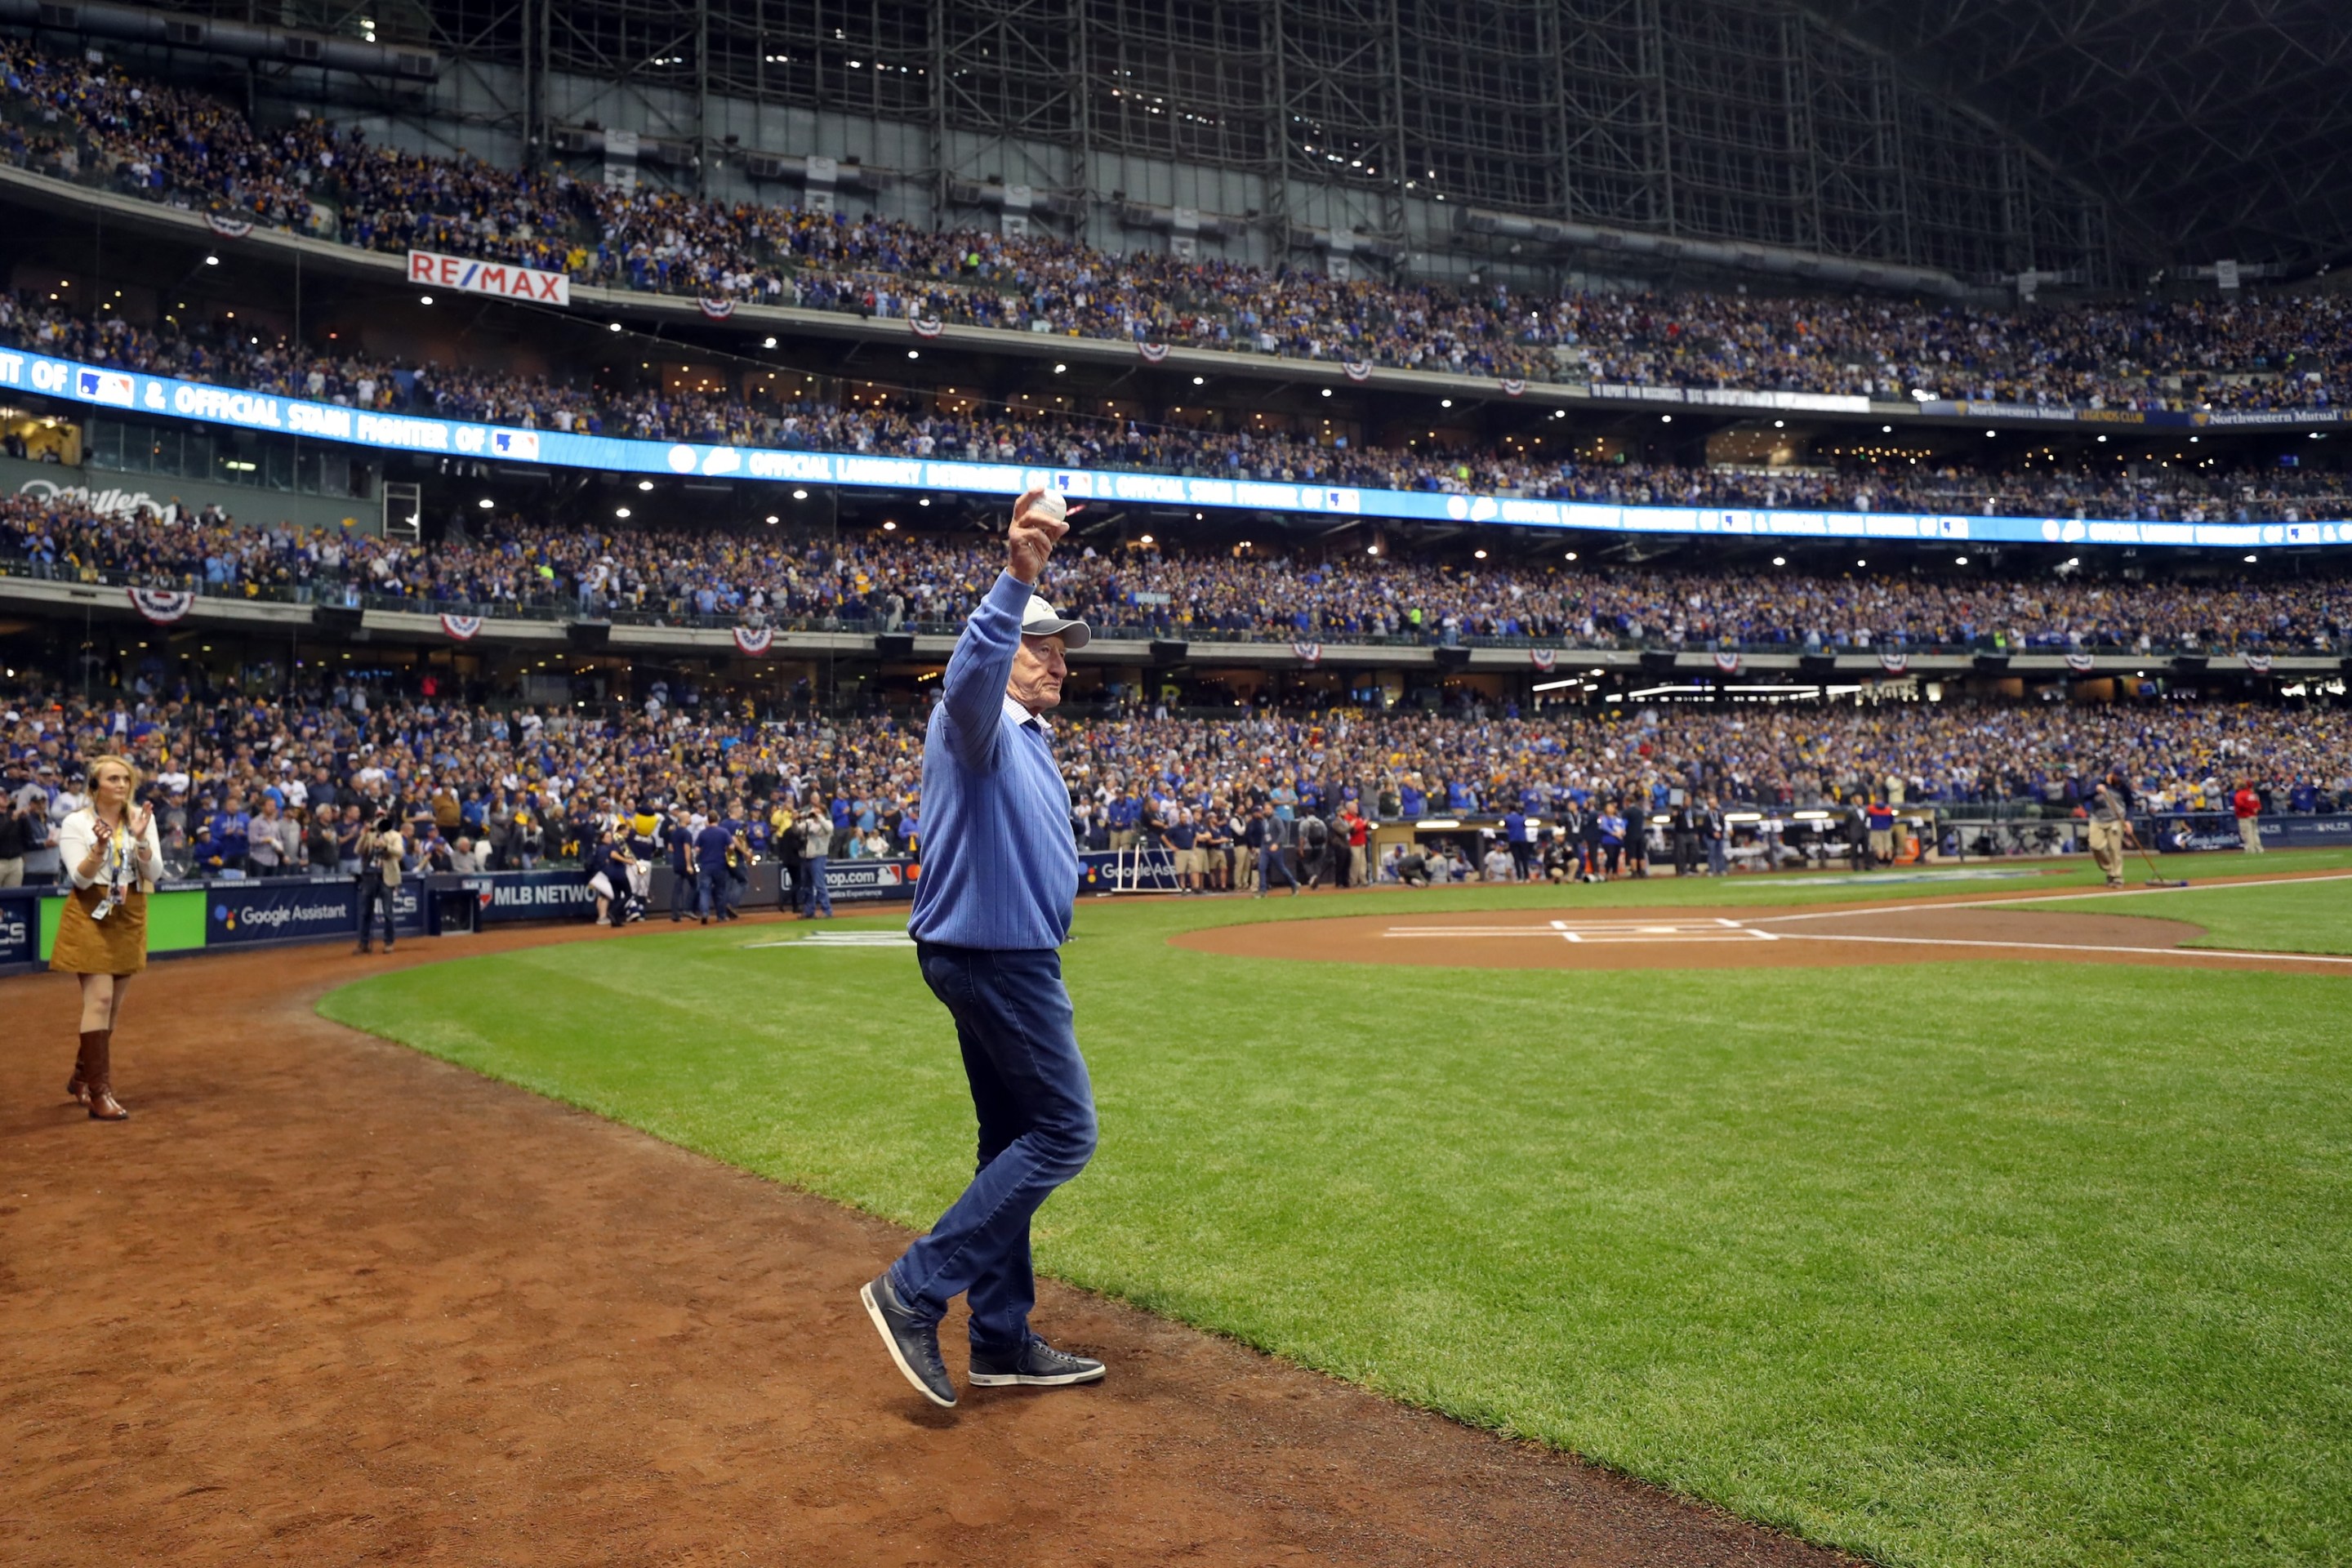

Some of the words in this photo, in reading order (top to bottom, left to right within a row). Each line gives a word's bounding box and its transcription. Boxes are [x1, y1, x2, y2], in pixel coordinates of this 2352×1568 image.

[412, 253, 560, 301] RE/MAX
[32, 360, 69, 392] OF
[175, 385, 281, 427] OFFICIAL
[287, 403, 351, 438] STAIN
[358, 415, 448, 449] FIGHTER
[455, 426, 485, 452] OF
[1968, 403, 2037, 419] Northwestern
[2038, 408, 2074, 420] Mutual
[2078, 410, 2118, 422] LEGENDS
[2121, 412, 2144, 423] CLUB
[2209, 412, 2292, 425] Northwestern
[2294, 408, 2338, 422] Mutual
[749, 452, 831, 480] OFFICIAL
[835, 457, 922, 485] LAUNDRY
[495, 887, 532, 906] MLB
[536, 884, 596, 904] NETWO
[242, 906, 290, 928] Google
[292, 902, 346, 920] Assistant
